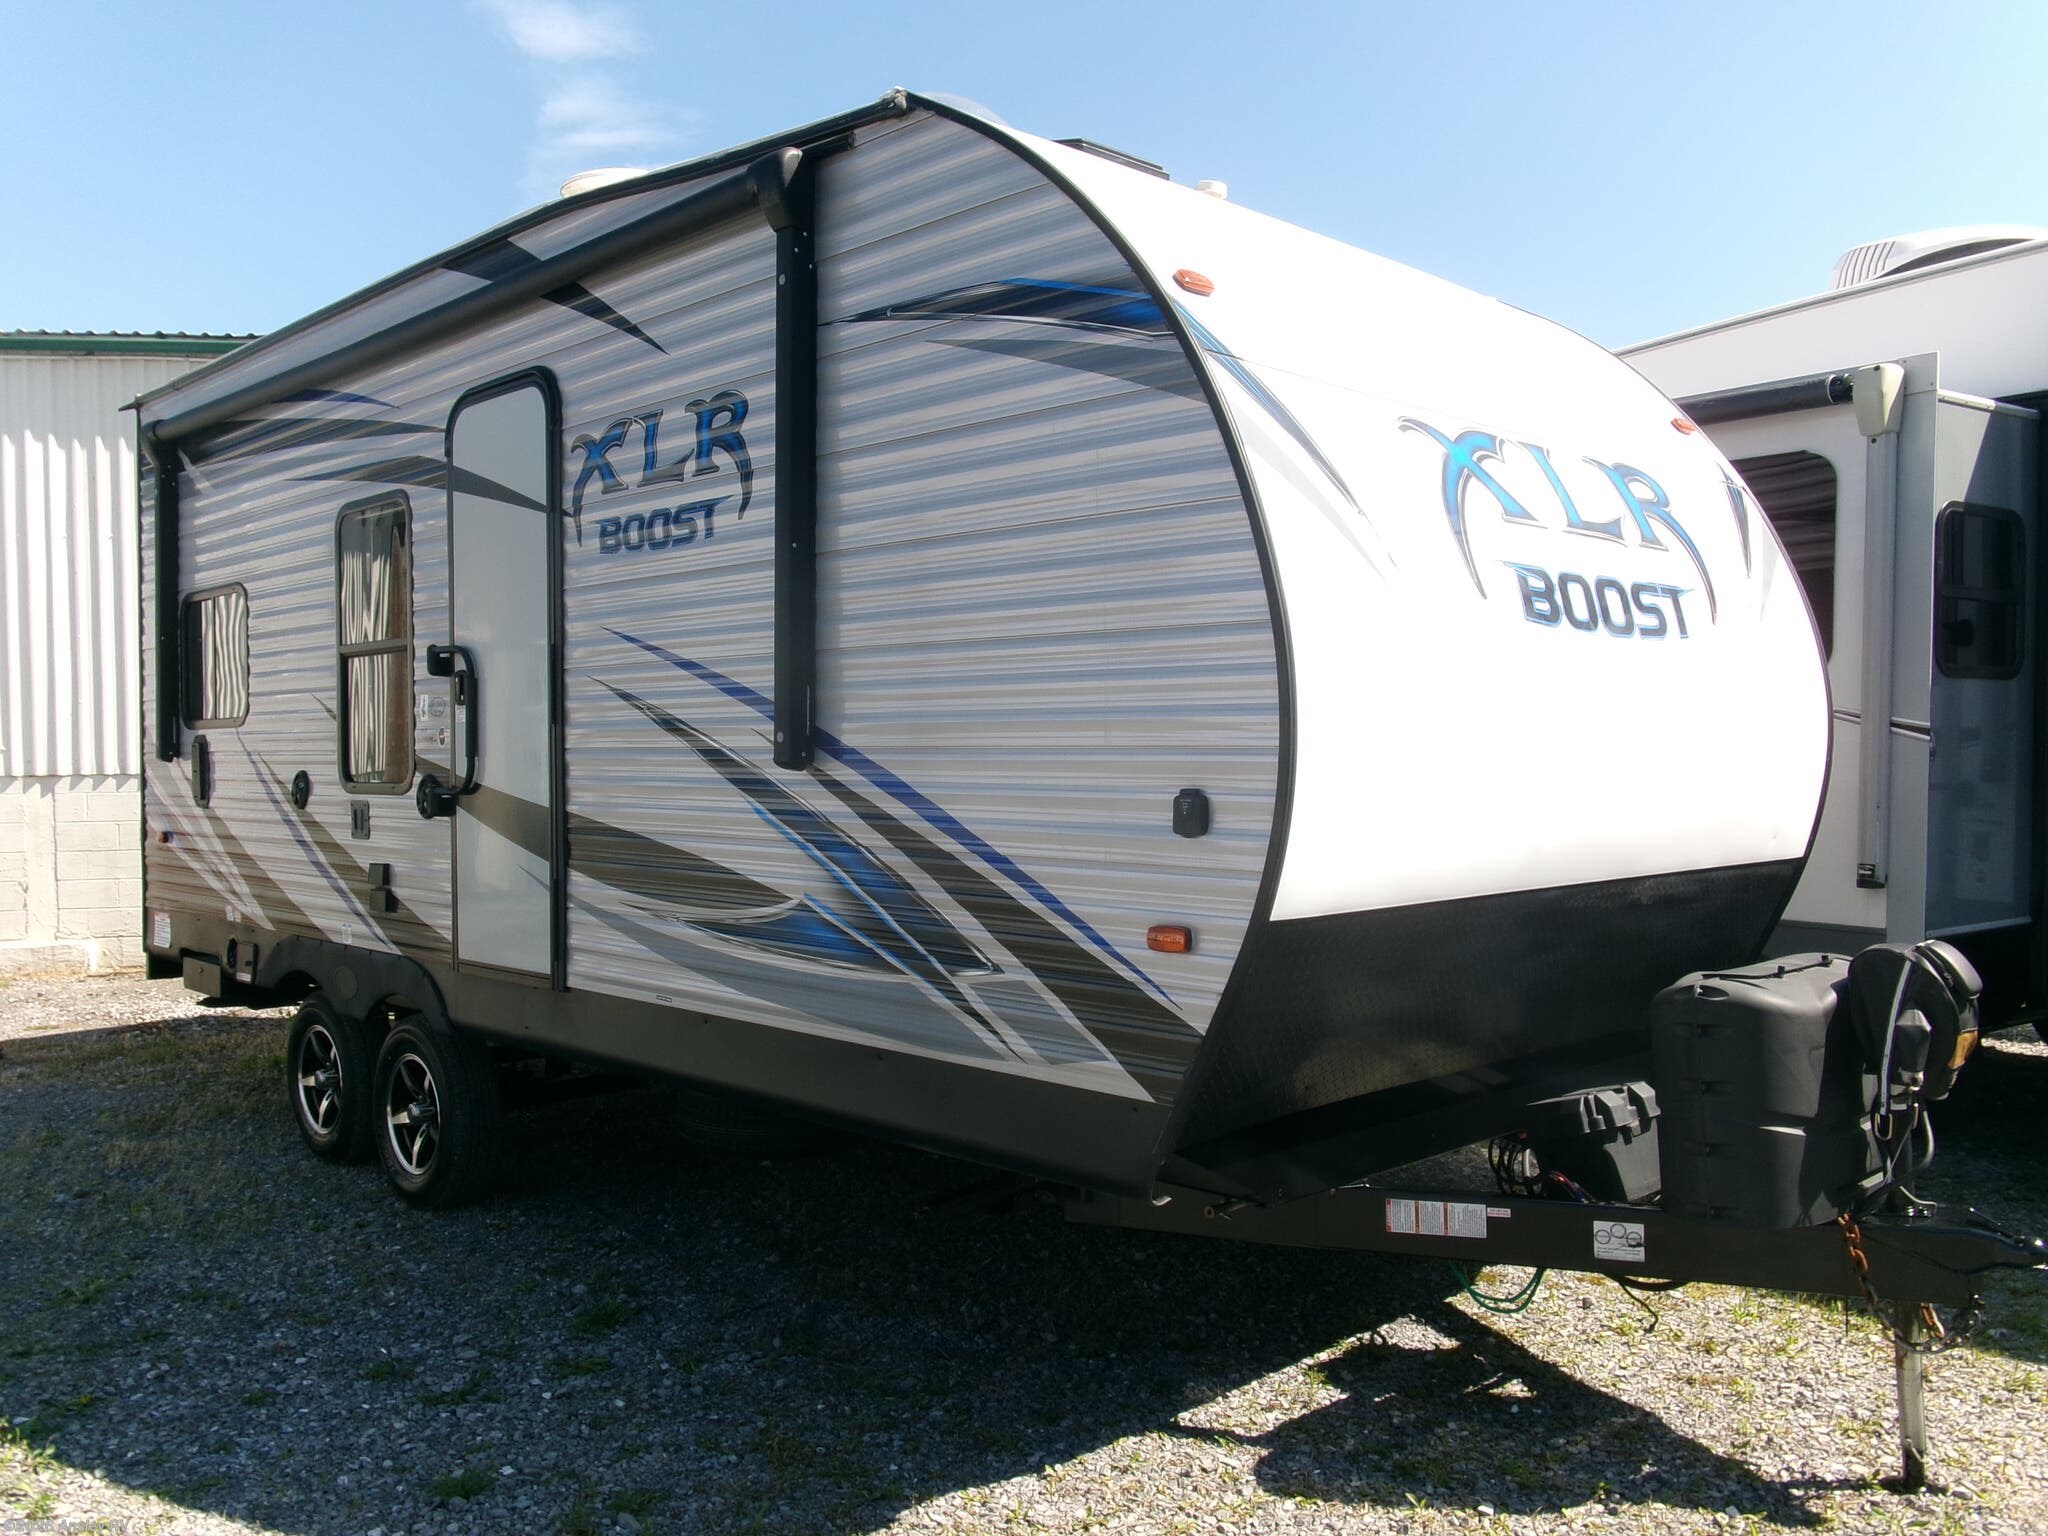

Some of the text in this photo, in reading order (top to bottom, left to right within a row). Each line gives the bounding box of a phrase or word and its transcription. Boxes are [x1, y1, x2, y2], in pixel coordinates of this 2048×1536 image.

[570, 389, 754, 547] XLR
[596, 494, 735, 555] BOOST
[1398, 415, 1718, 625] XLR
[1500, 560, 1694, 640] BOOST
